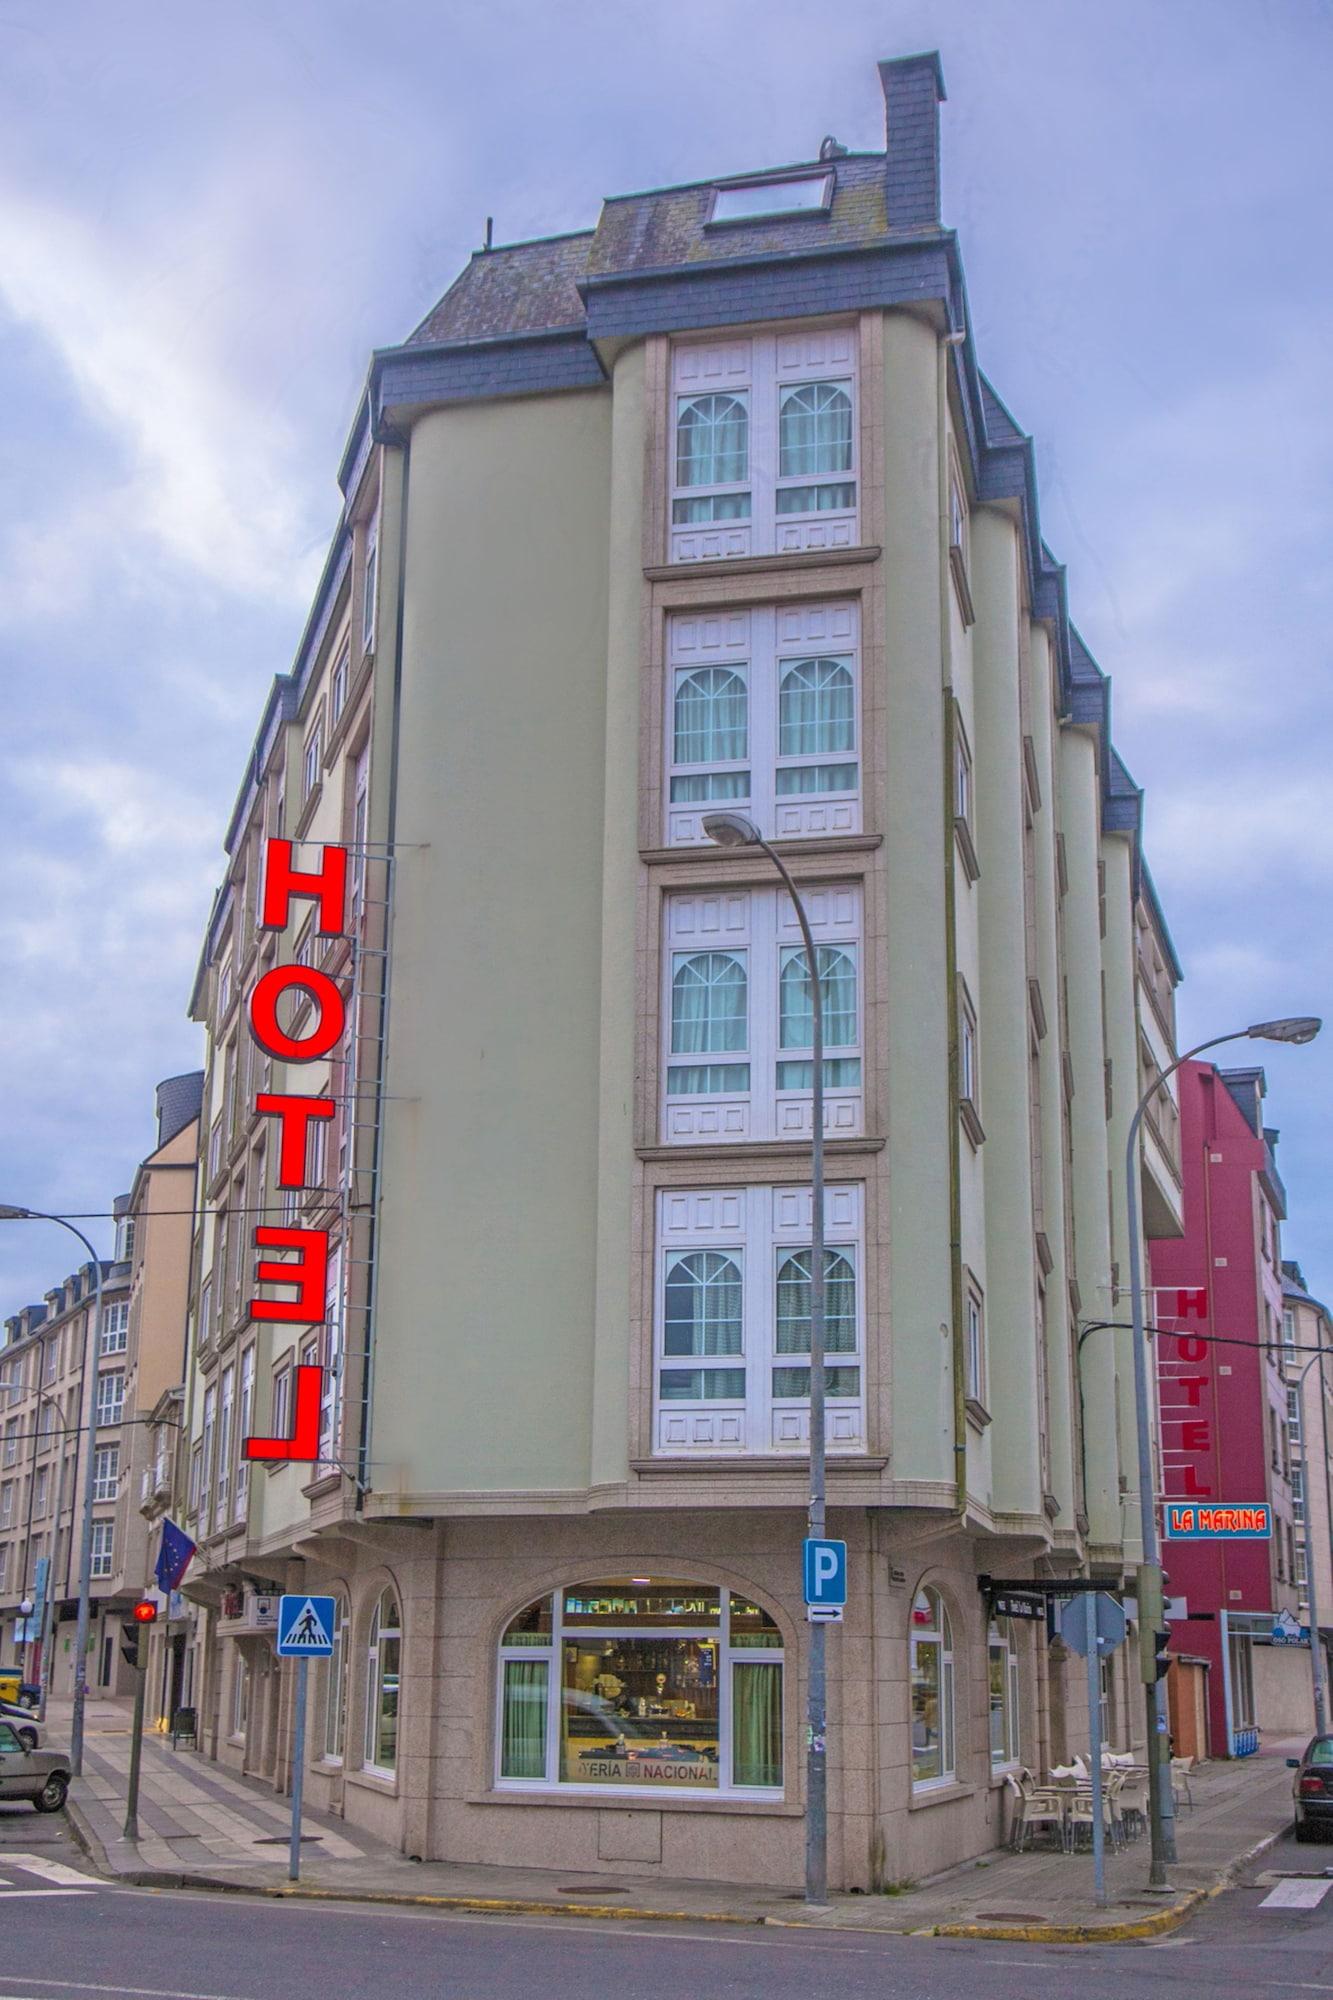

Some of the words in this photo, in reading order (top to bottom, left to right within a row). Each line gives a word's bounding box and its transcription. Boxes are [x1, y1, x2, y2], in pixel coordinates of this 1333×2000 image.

[1177, 1289, 1211, 1495] HOTEL
[1172, 1509, 1194, 1532] LA
[1198, 1509, 1267, 1533] MARINA
[815, 1547, 838, 1597] P
[643, 1764, 718, 1781] NACIONAL
